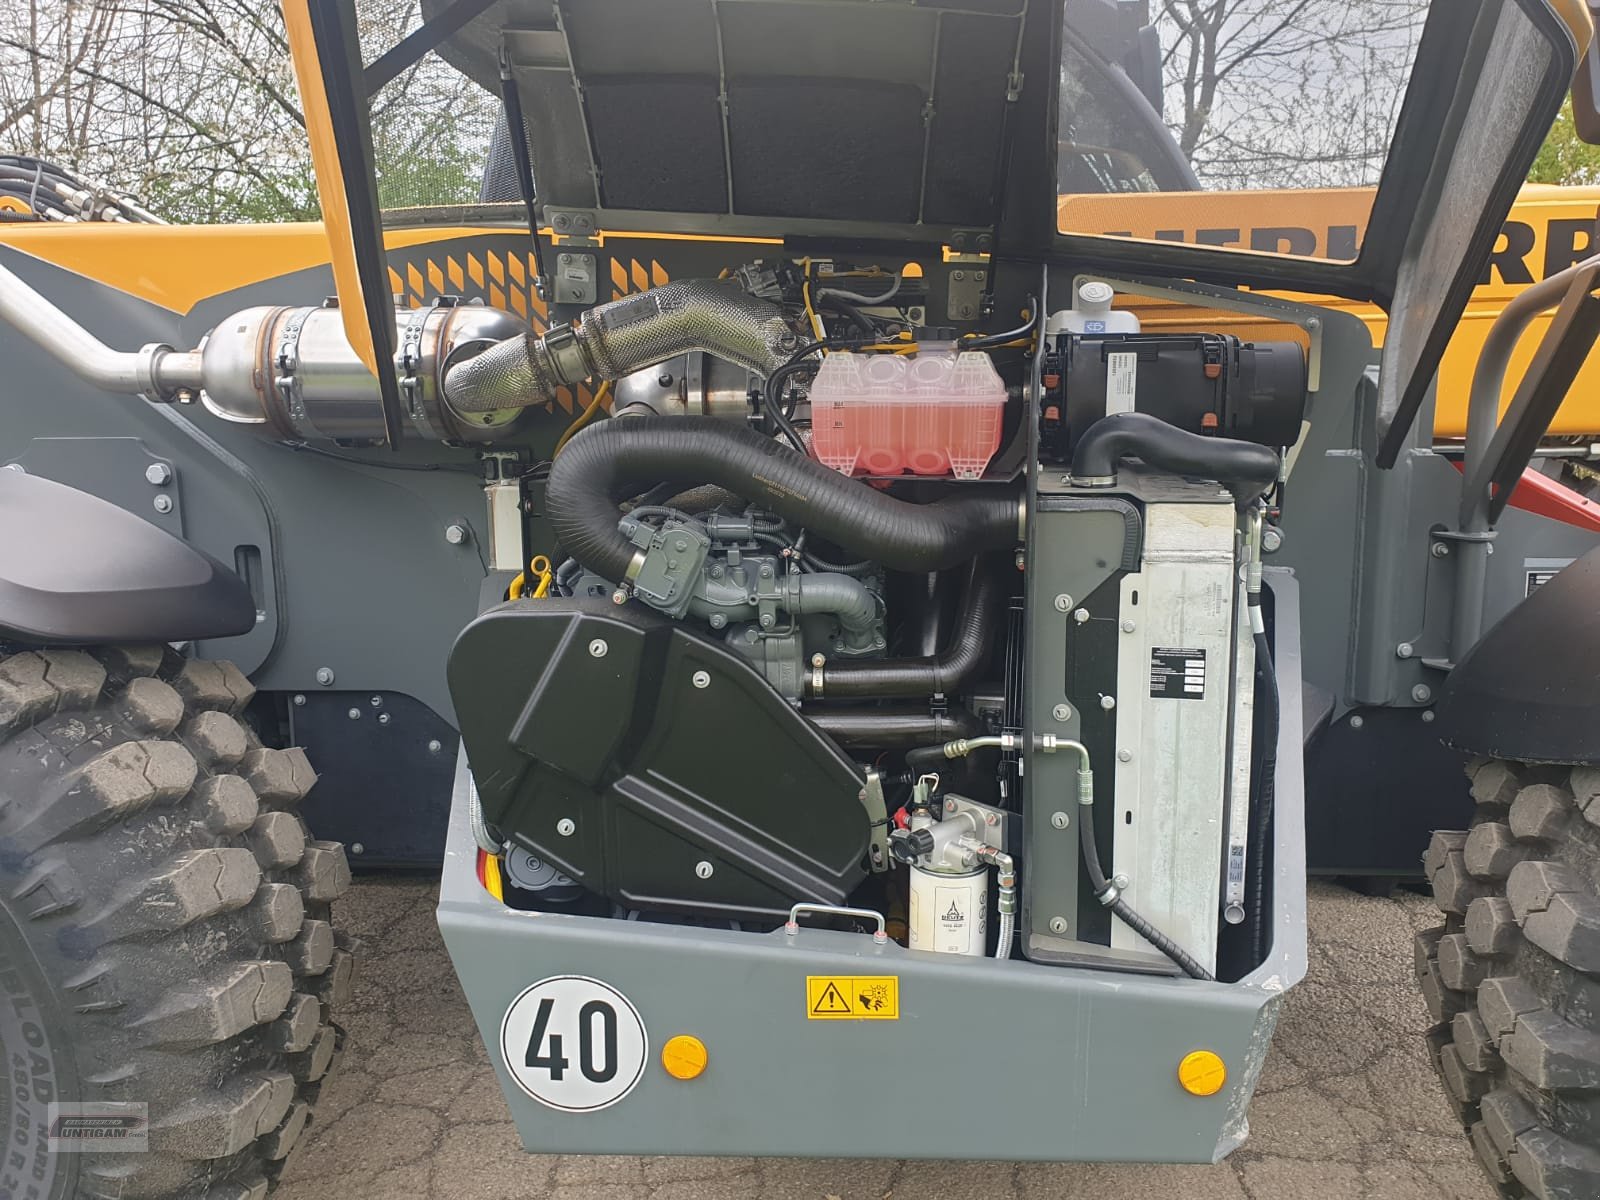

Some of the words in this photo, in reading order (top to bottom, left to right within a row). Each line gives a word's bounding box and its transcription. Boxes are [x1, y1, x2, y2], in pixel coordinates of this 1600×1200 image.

[525, 998, 618, 1083] 40
[14, 1052, 30, 1146] 480/80
[9, 1151, 27, 1171] R
